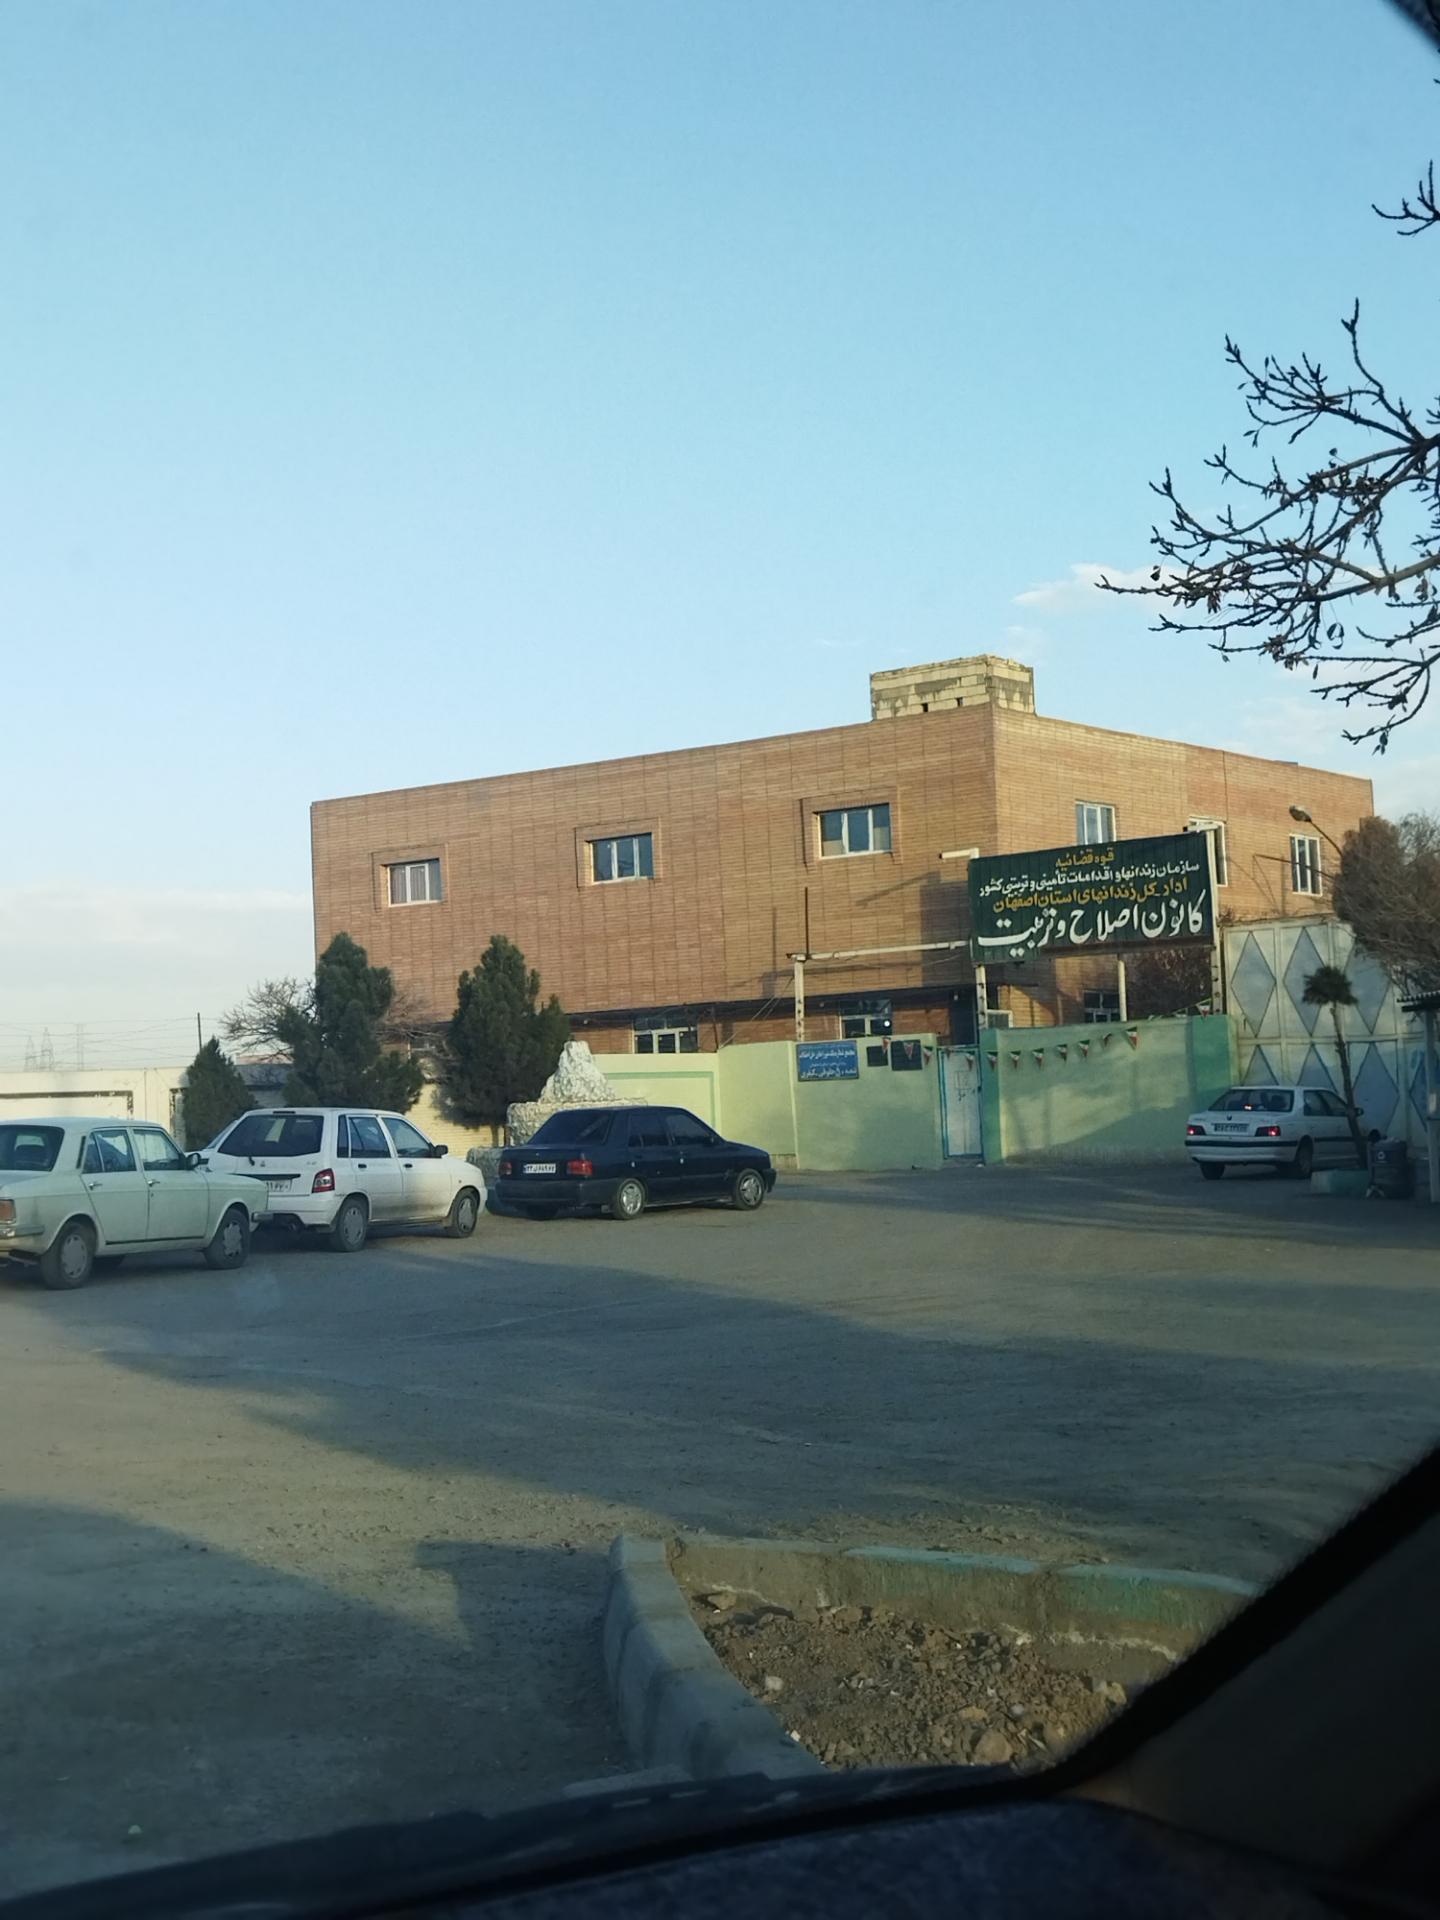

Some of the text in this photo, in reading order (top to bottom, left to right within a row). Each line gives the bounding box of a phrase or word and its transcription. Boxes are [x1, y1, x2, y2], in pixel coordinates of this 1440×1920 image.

[1055, 847, 1115, 872] قوه قضائیه
[1156, 860, 1200, 879] سازمان
[1067, 866, 1113, 883] اقدامات
[979, 878, 1003, 897] کشور
[1002, 874, 1029, 898] تربیتی
[1029, 880, 1036, 892] و
[1077, 882, 1136, 905] زندانهای
[993, 892, 1038, 913] اصفهان
[1039, 888, 1077, 908] استان
[978, 889, 1206, 958] کانون اصلاح و تربیت
